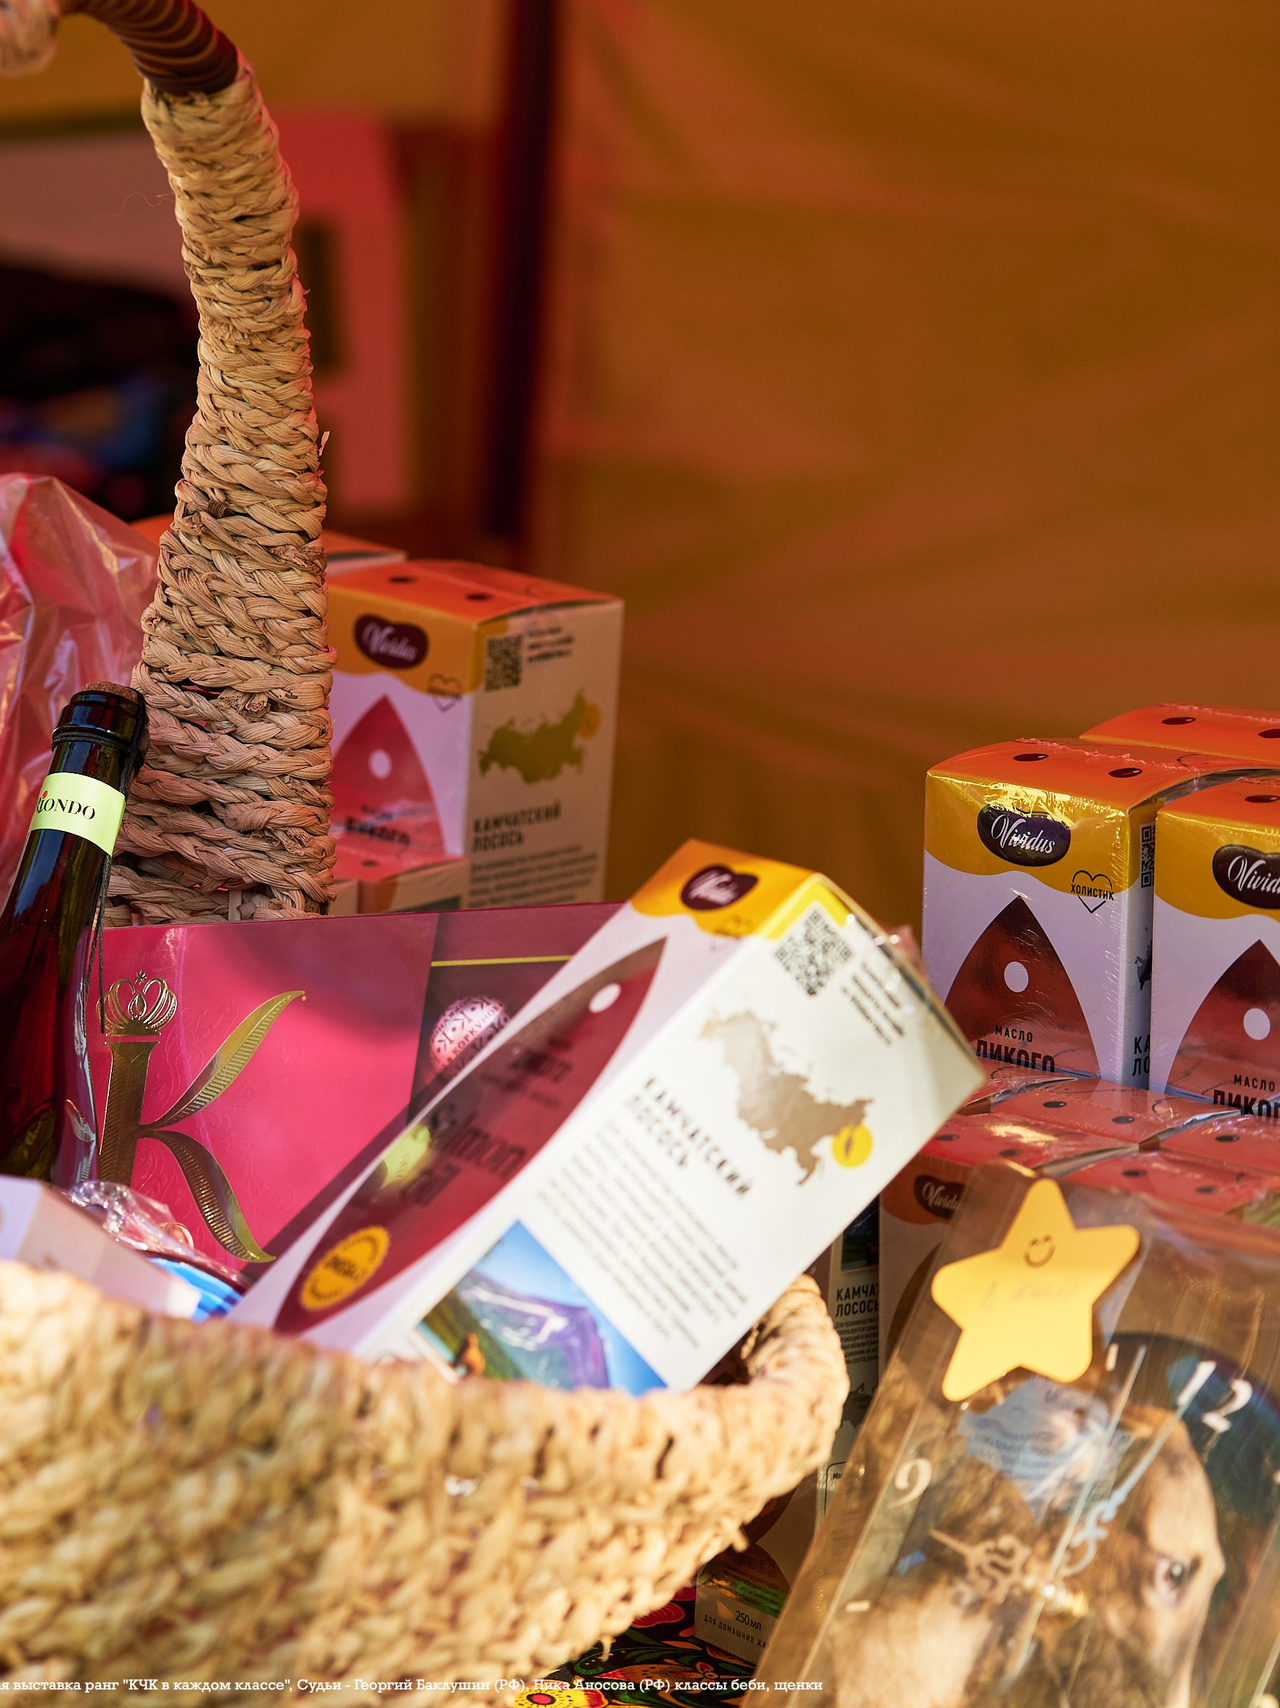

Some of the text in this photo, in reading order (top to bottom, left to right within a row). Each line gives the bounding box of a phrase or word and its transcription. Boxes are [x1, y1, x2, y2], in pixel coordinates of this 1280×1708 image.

[990, 814, 1056, 854] Vividus
[1227, 854, 1280, 895] Vivid
[995, 1024, 1033, 1042] МАСЛО
[1234, 1073, 1276, 1093] МАСЛО
[1213, 1088, 1280, 1119] ДИКОГ
[836, 1283, 879, 1302] КАМЧА
[1177, 1360, 1254, 1434] 12
